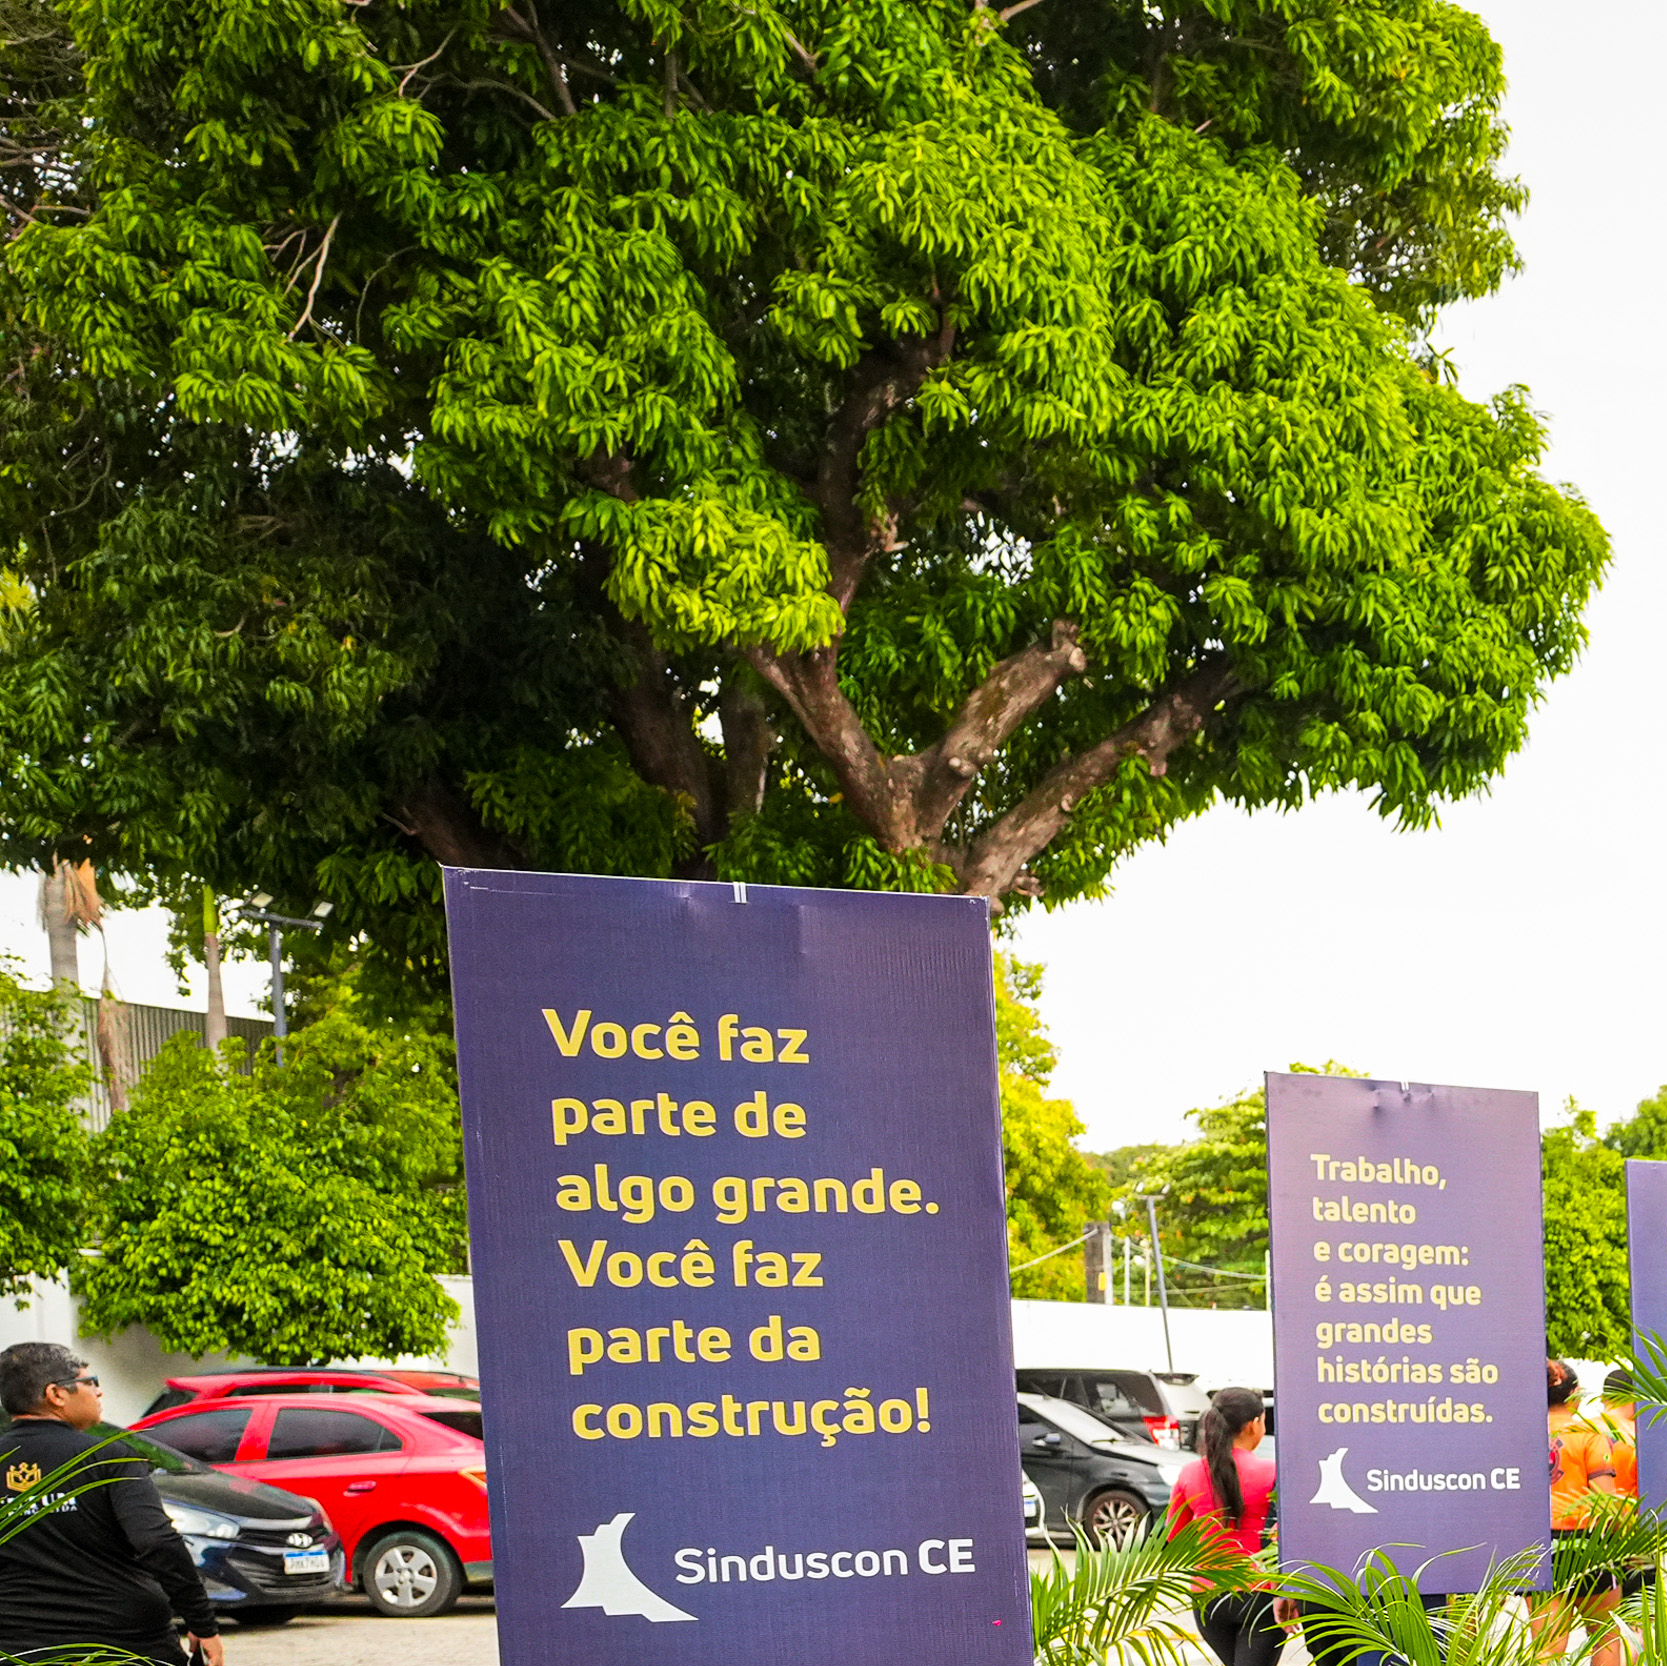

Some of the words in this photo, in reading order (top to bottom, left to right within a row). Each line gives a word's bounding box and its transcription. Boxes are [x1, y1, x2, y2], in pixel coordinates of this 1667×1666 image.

[541, 1008, 700, 1061] Você
[717, 1013, 810, 1064] faz
[551, 1092, 717, 1146] parte
[733, 1090, 807, 1139] de
[1309, 1153, 1447, 1191] Trabalho,
[555, 1163, 695, 1224] algo
[712, 1167, 940, 1225] grande.
[1312, 1195, 1416, 1225] talento
[557, 1238, 715, 1288] Você
[732, 1239, 824, 1288] faz
[1313, 1241, 1331, 1262] e
[1337, 1242, 1469, 1271] coragem:
[1314, 1274, 1332, 1303] é
[1338, 1275, 1423, 1304] assim
[1429, 1284, 1482, 1311] que
[567, 1319, 732, 1376] parte
[748, 1314, 821, 1362] da
[1315, 1317, 1433, 1350] grandes
[1317, 1355, 1443, 1384] histórias
[1449, 1357, 1499, 1385] são
[572, 1387, 931, 1448] construção!
[1318, 1395, 1493, 1424] construídas.
[1366, 1468, 1486, 1492] Sinduscon
[1490, 1467, 1521, 1490] CE
[674, 1545, 909, 1584] Sinduscon
[918, 1538, 976, 1575] CE
